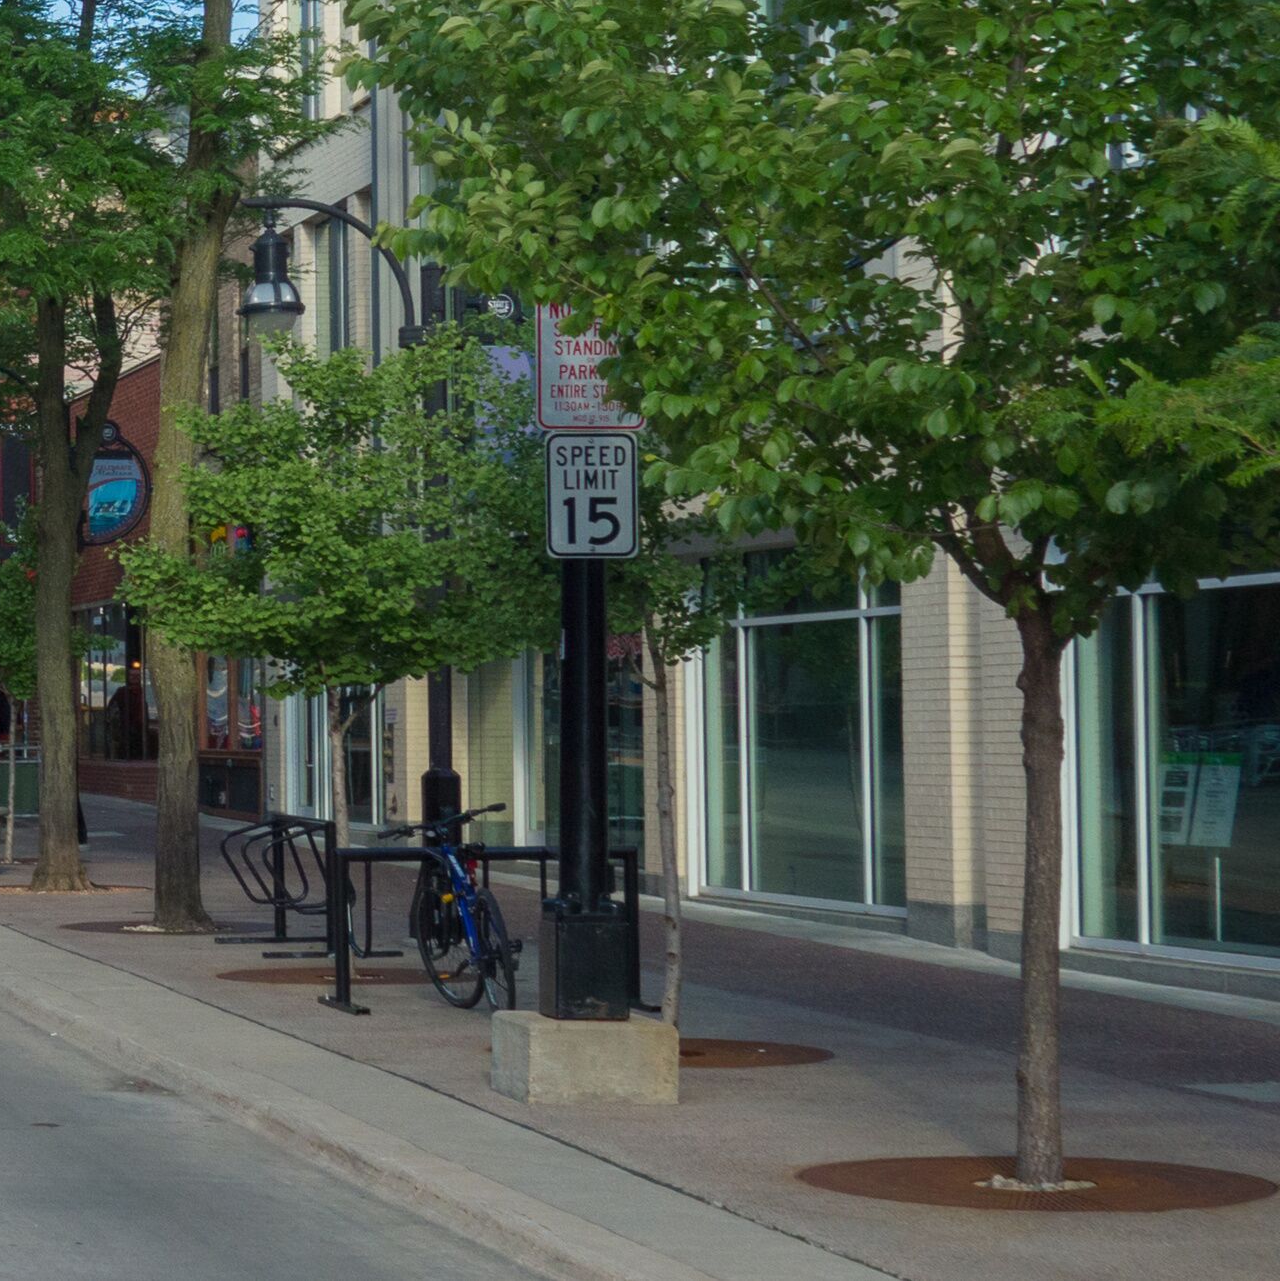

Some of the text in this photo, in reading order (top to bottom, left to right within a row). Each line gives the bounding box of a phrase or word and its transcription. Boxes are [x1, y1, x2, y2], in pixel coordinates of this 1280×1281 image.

[554, 340, 618, 356] STANDIN
[559, 365, 598, 380] PARK
[550, 384, 587, 399] ENTIRE
[556, 445, 626, 467] SPEED
[563, 469, 619, 490] LIMIT
[563, 496, 621, 546] 15
